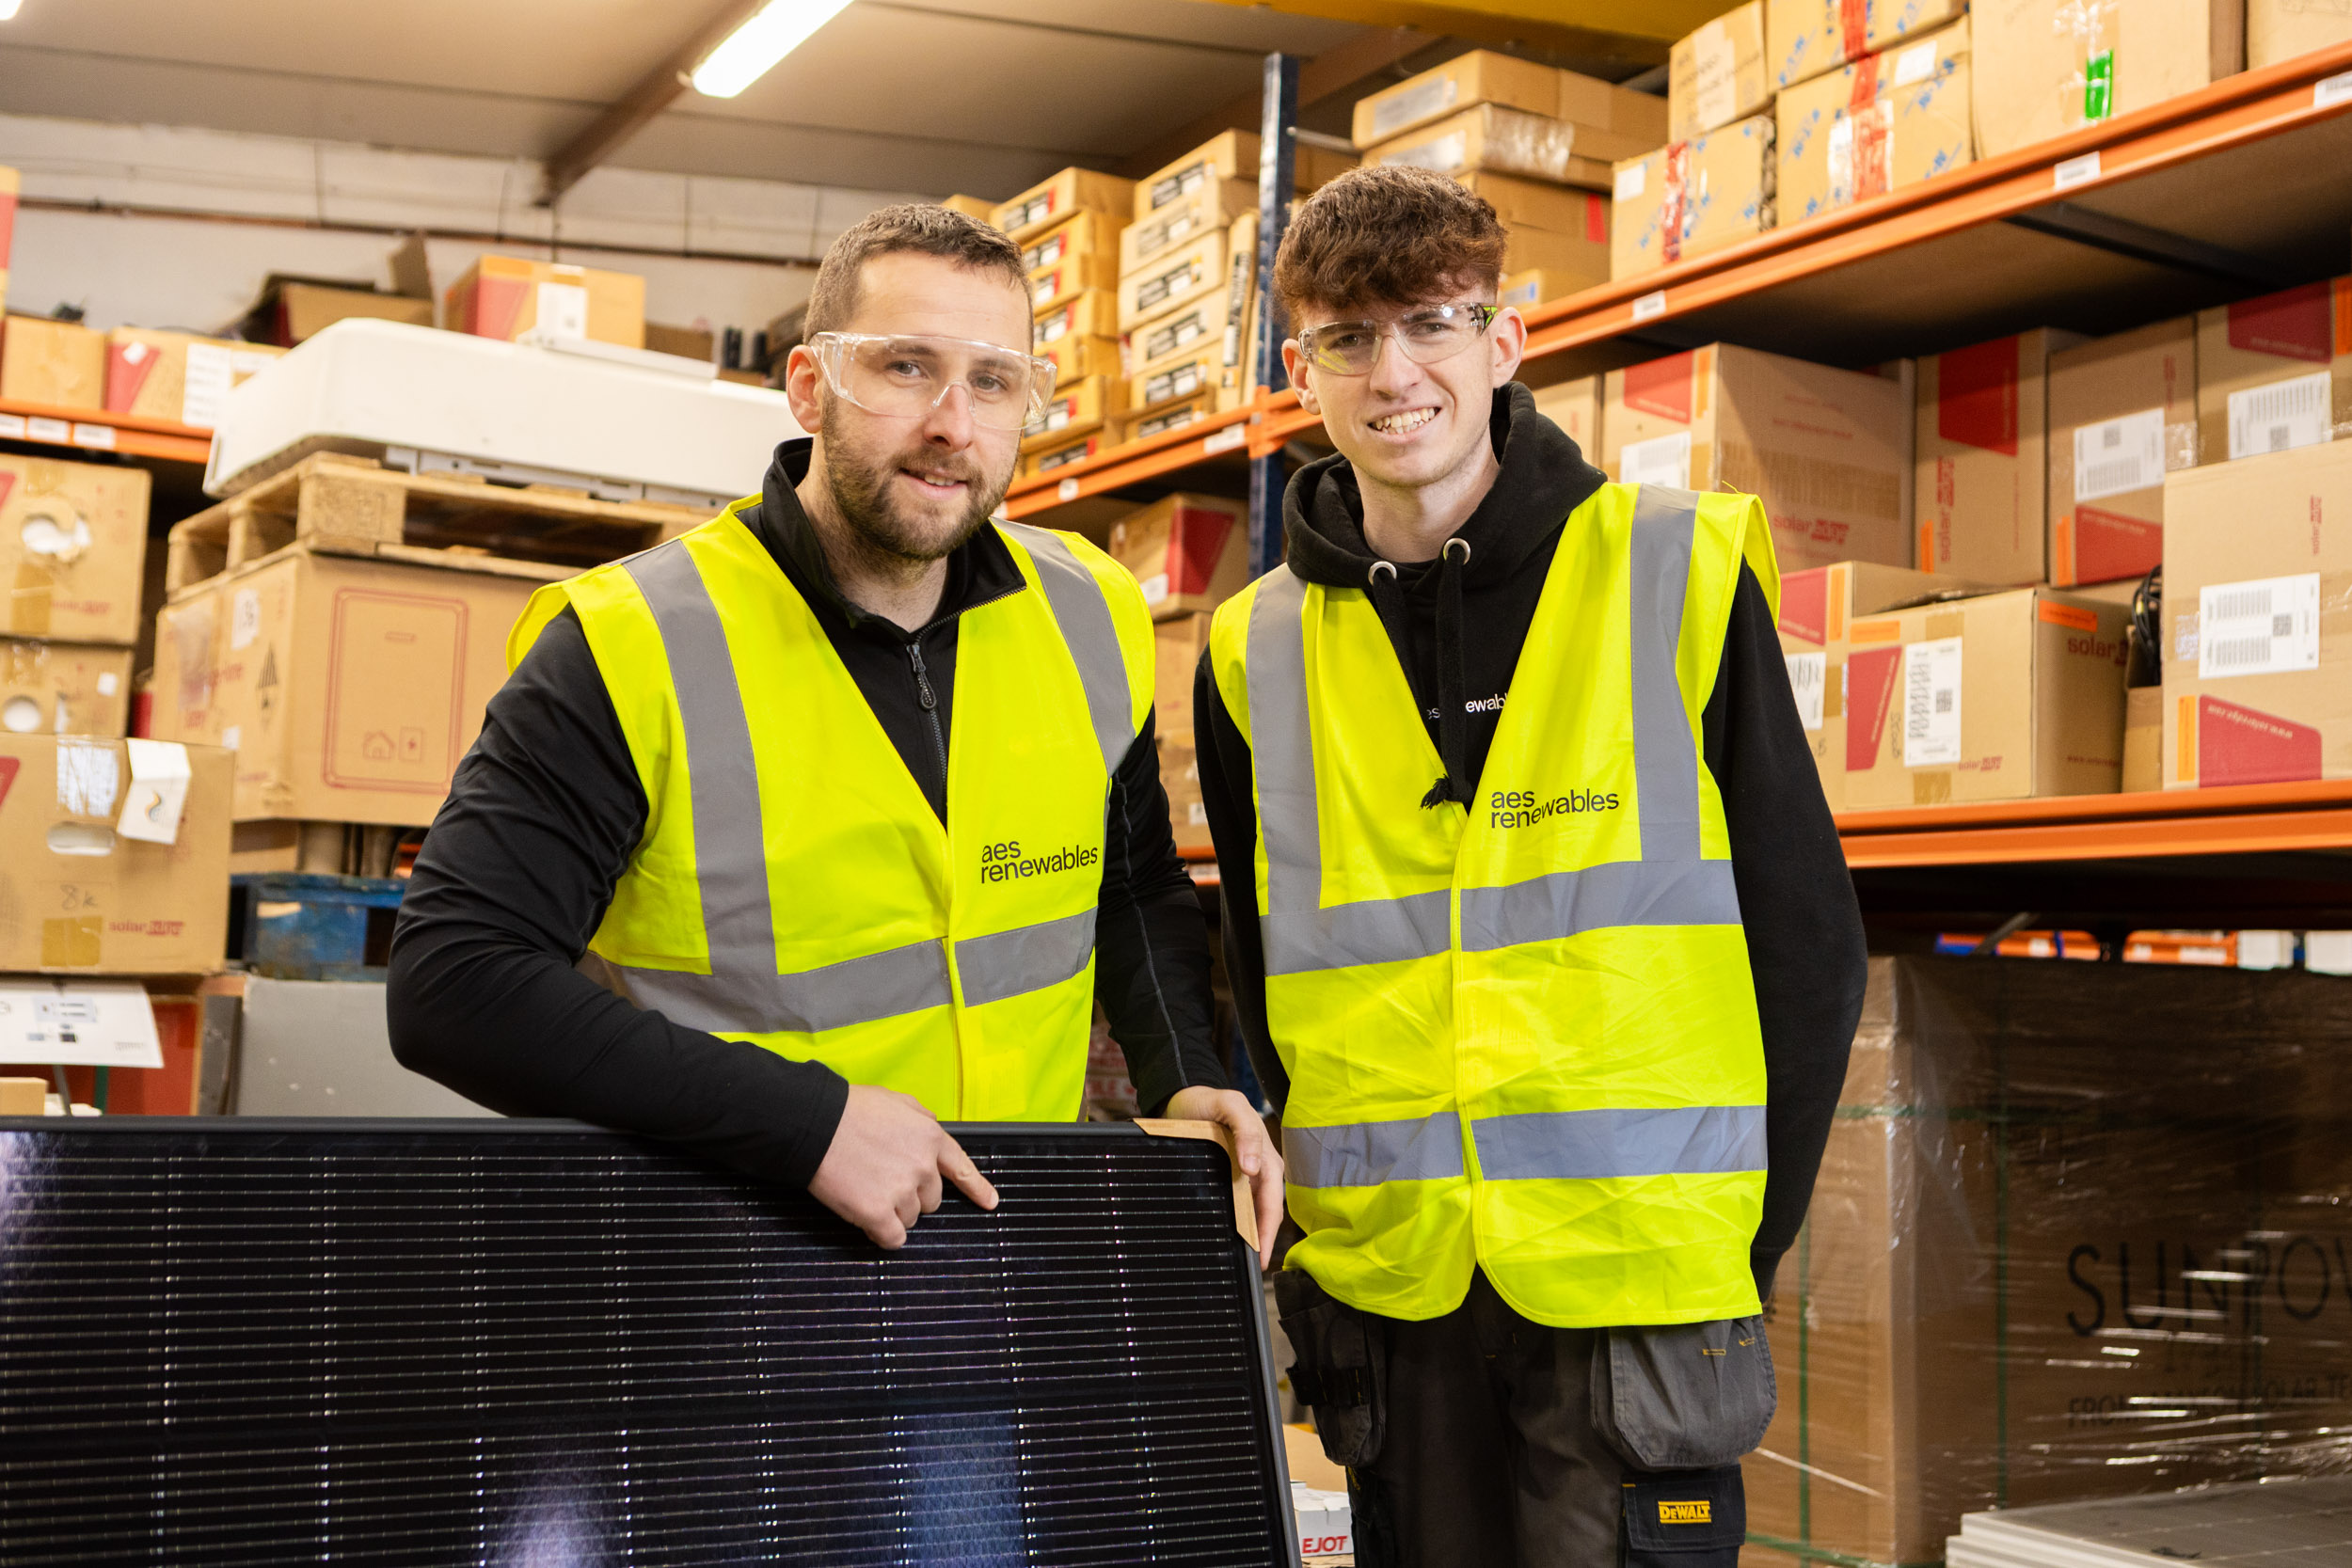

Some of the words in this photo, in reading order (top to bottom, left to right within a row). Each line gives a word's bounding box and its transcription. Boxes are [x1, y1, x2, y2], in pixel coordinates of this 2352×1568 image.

[1490, 790, 1535, 809] aes
[1490, 788, 1620, 829] renewables
[981, 841, 1022, 863] aes
[981, 845, 1099, 884] renewables
[1302, 1535, 1348, 1554] EJOT
